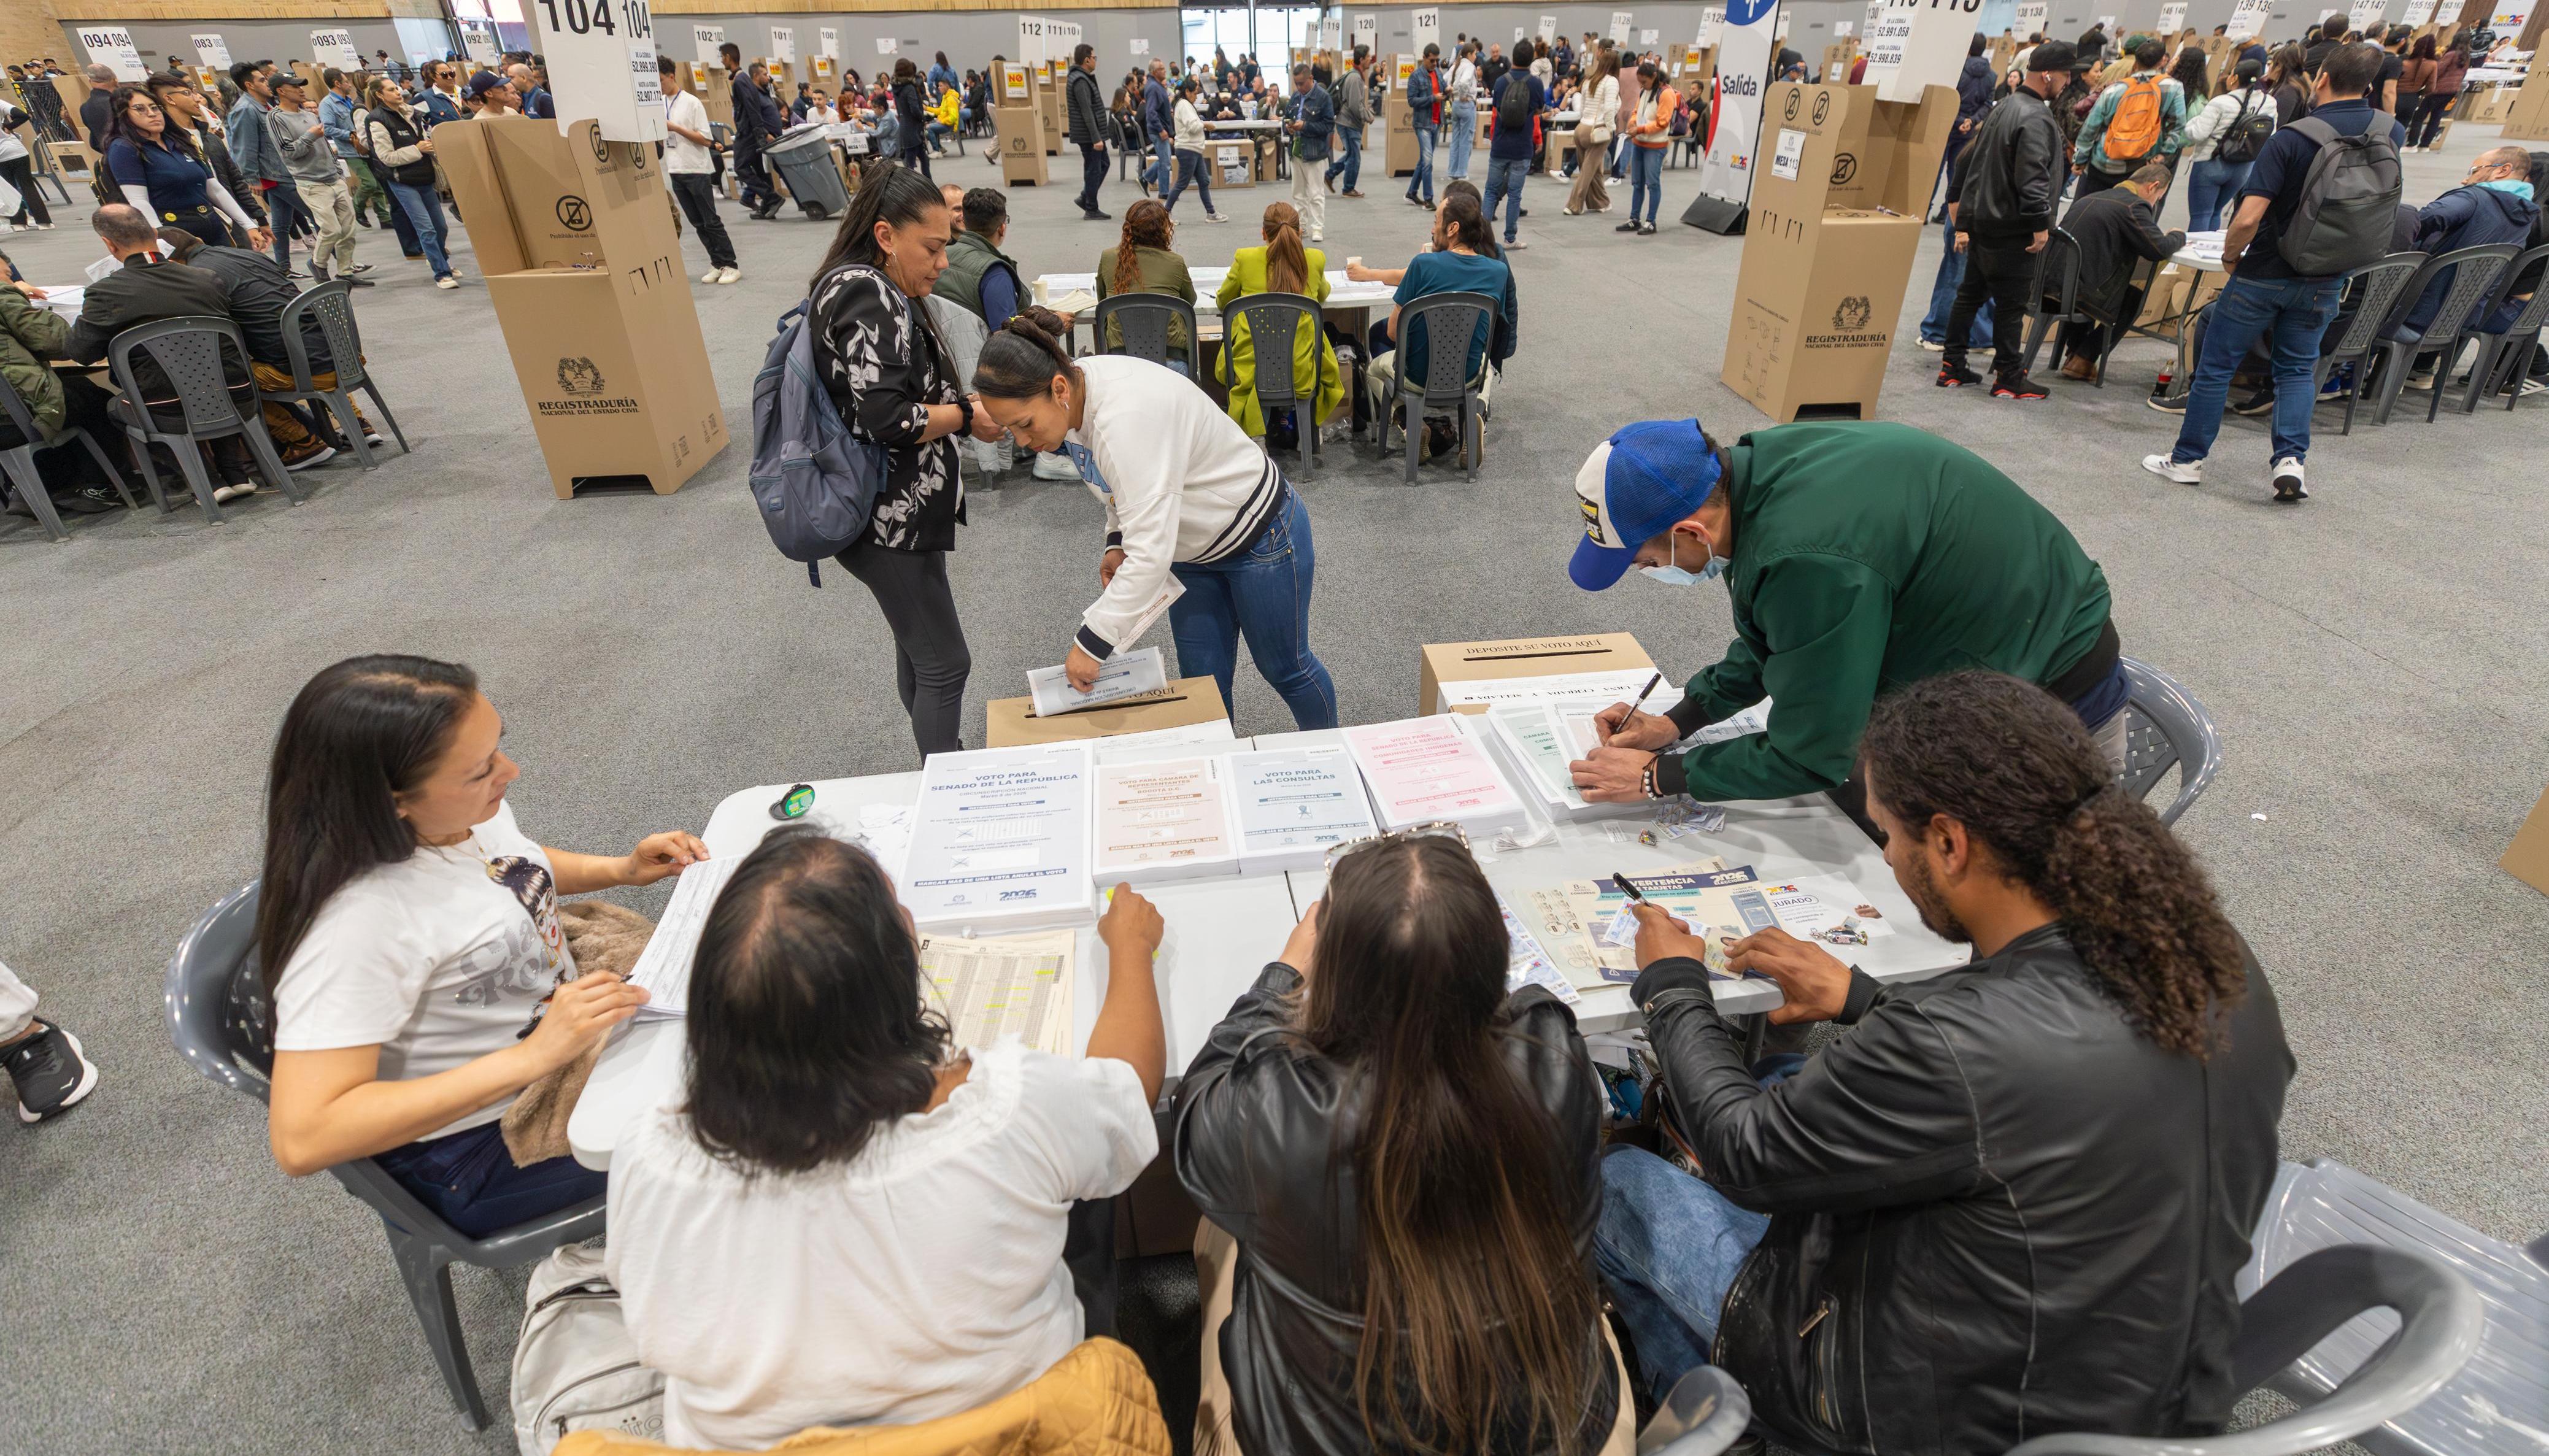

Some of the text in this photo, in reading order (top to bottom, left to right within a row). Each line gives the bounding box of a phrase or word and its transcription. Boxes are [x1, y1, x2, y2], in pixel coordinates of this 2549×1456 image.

[2354, 1, 2367, 10] 147
[2370, 1, 2386, 10] 147
[1711, 12, 1726, 23] 129
[2029, 7, 2043, 17] 138
[539, 0, 615, 36] 104
[622, 0, 651, 39] 104
[1418, 13, 1436, 27] 121
[1618, 16, 1632, 25] 128
[1021, 22, 1041, 36] 112
[1328, 22, 1340, 31] 119
[1359, 19, 1374, 29] 120
[773, 31, 787, 40] 101
[1047, 24, 1062, 36] 111
[1877, 26, 1910, 37] 52.991.058
[83, 34, 112, 48] 094
[112, 33, 132, 47] 094
[317, 34, 337, 47] 093
[337, 34, 352, 45] 093
[466, 34, 482, 44] 092
[696, 31, 713, 42] 102
[194, 39, 213, 48] 083
[1870, 53, 1902, 64] 52.998.839
[1722, 74, 1757, 96] Salida
[1775, 155, 1799, 170] MESA 113
[1806, 331, 1887, 344] REGISTRADURÍA
[538, 396, 638, 410] REGISTRADURÍA
[1467, 644, 1523, 655] DEPOSITE
[1543, 641, 1572, 650] VOTO
[1575, 638, 1602, 647] AQUÍ
[1070, 687, 1136, 706] CIRCUNSCRIPCIÓN NACIONAL
[1146, 686, 1176, 698] AQUÍ
[1374, 748, 1424, 759] COMUNIDADES
[931, 783, 978, 792] SENADO
[1016, 774, 1079, 785] REPÚBLICA
[1127, 779, 1191, 789] REPRESENTANTES
[1276, 774, 1336, 783] CONSULTAS
[958, 787, 1016, 796] CIRCUNSCRIPCIÓN
[1710, 870, 1749, 884] 2026
[1000, 888, 1037, 899] 2026
[1766, 884, 1798, 893] 2026
[1773, 897, 1813, 908] JURADO
